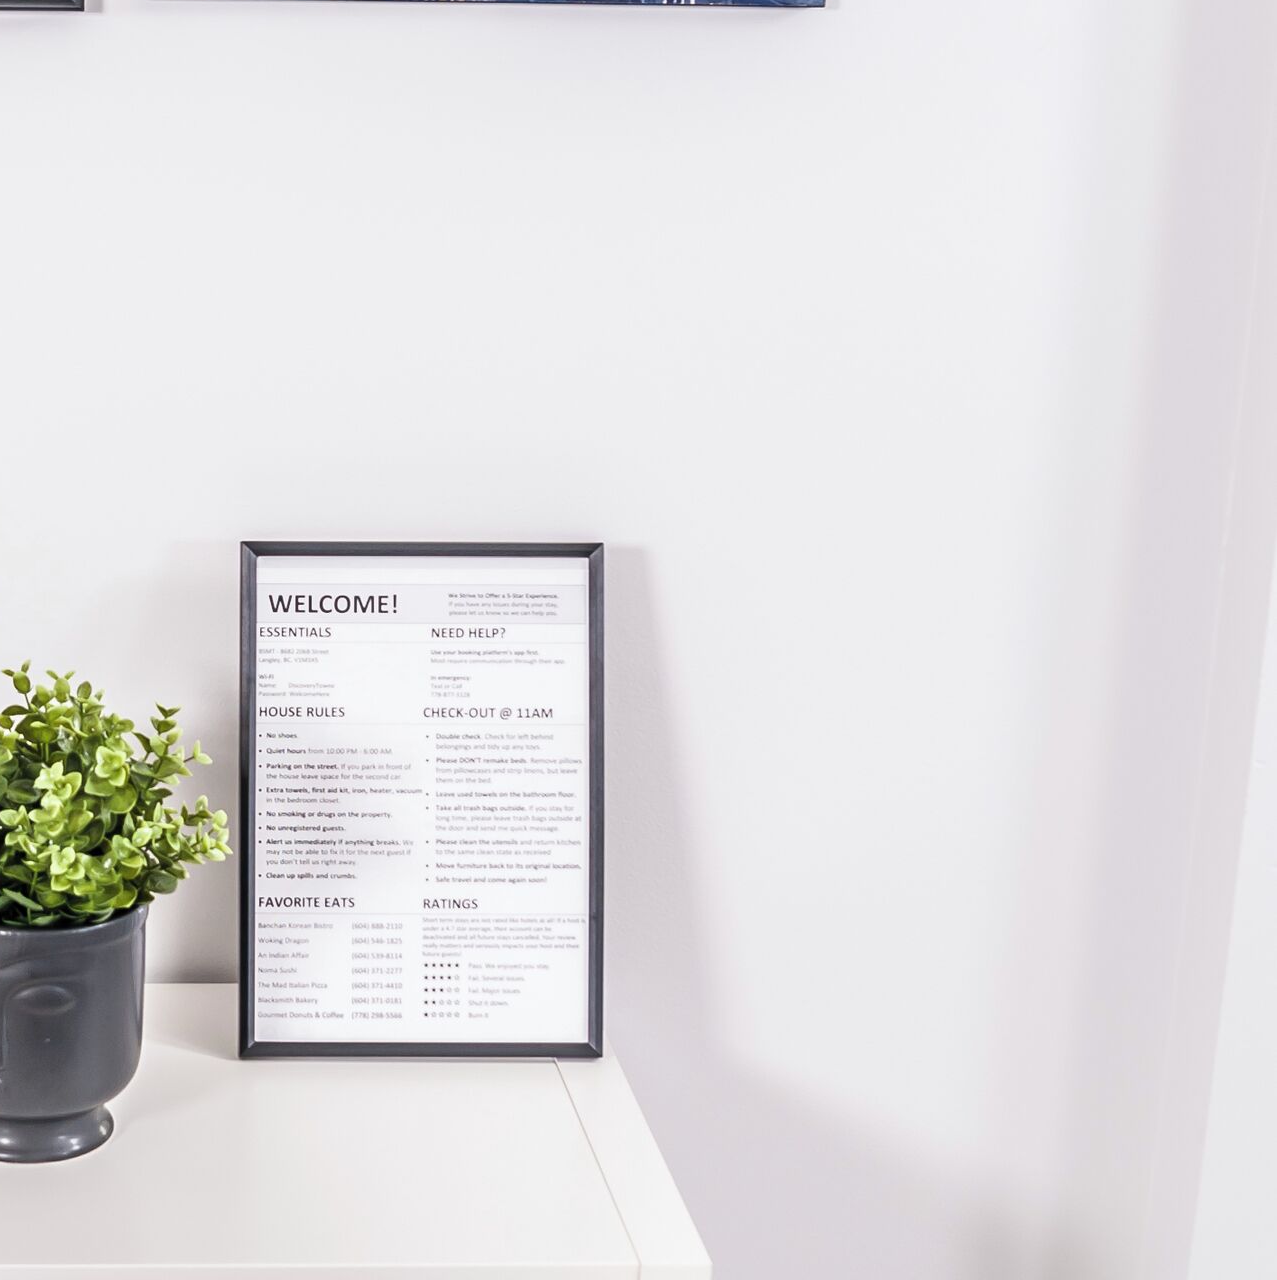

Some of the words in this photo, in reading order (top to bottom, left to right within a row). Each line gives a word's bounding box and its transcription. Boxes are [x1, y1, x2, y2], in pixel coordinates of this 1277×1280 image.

[269, 595, 396, 613] WELCOME!
[260, 627, 331, 637] ESSENTIALS
[432, 628, 464, 638] NEED
[469, 628, 505, 638] HELP?
[260, 707, 301, 717] HOUSE
[307, 707, 344, 717] RULES
[424, 708, 495, 718] CHECK-OUT
[500, 707, 512, 720] @
[518, 708, 552, 718] 11AM
[259, 897, 319, 907] FAVORITE
[325, 898, 354, 907] EATS
[424, 899, 478, 909] RATINGS
